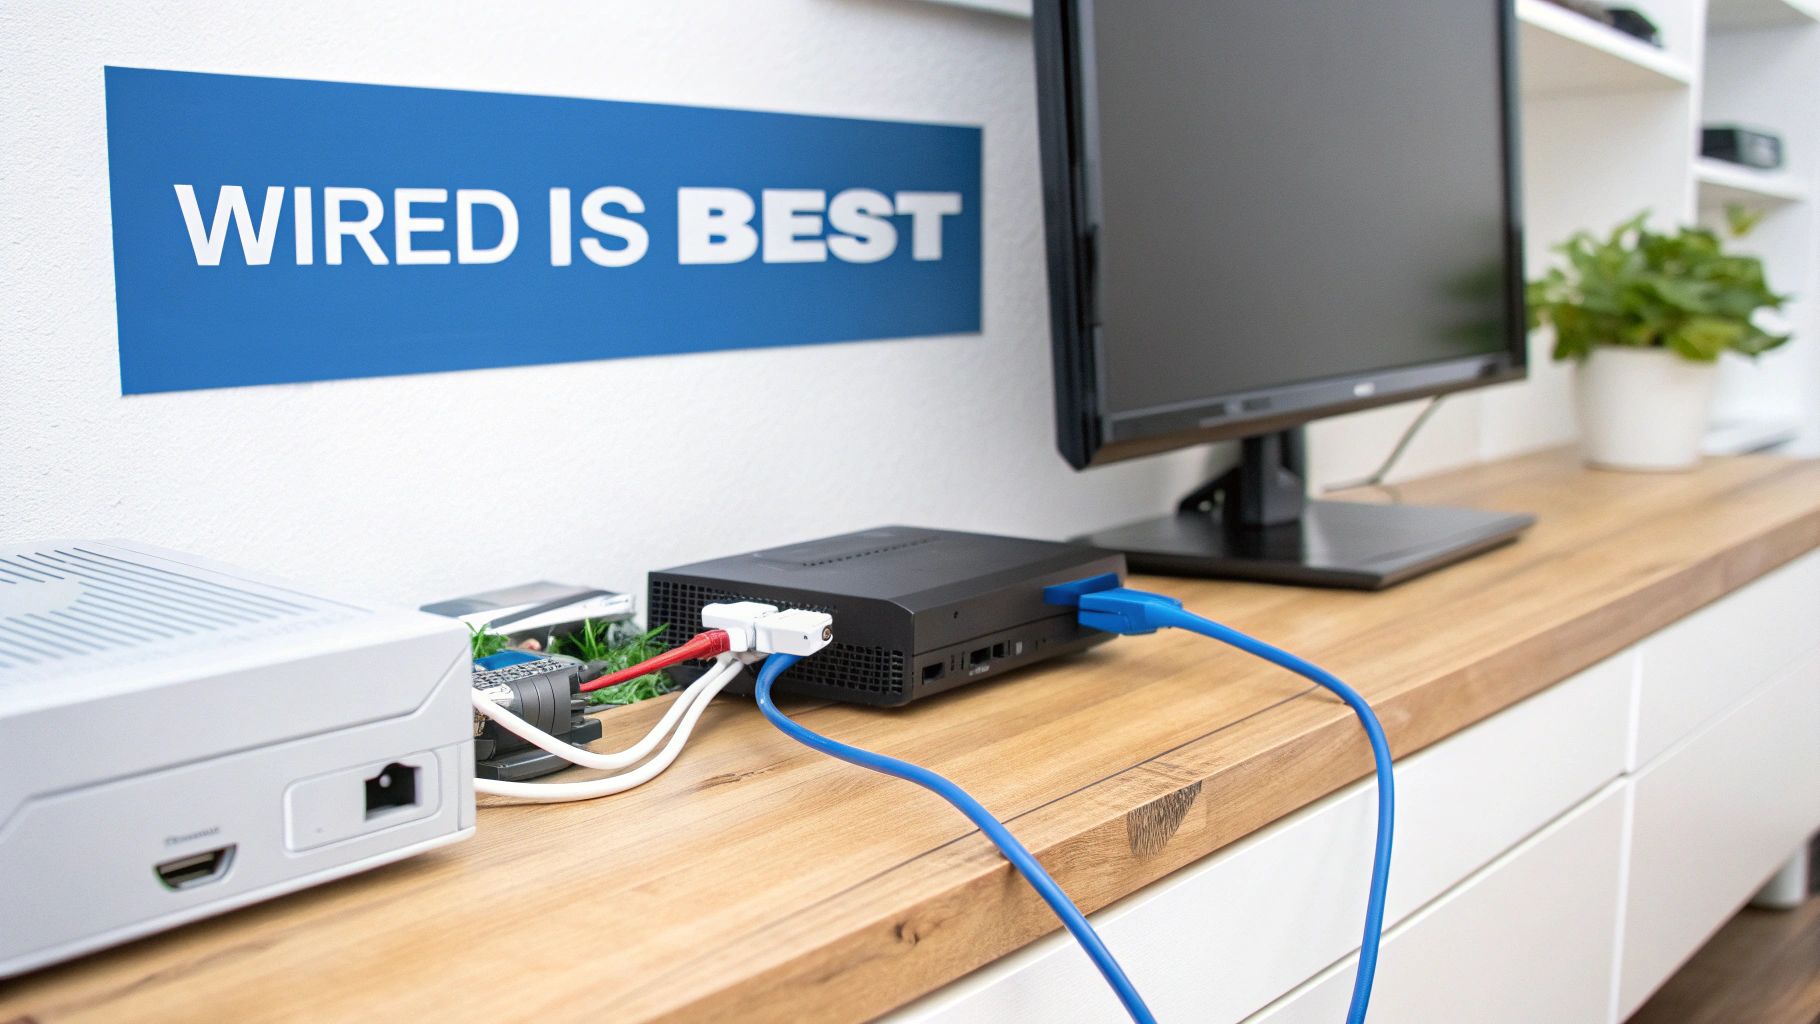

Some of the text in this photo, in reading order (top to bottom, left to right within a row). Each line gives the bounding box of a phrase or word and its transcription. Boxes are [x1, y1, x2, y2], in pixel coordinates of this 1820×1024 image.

[173, 184, 961, 268] WIRED IS BEST
